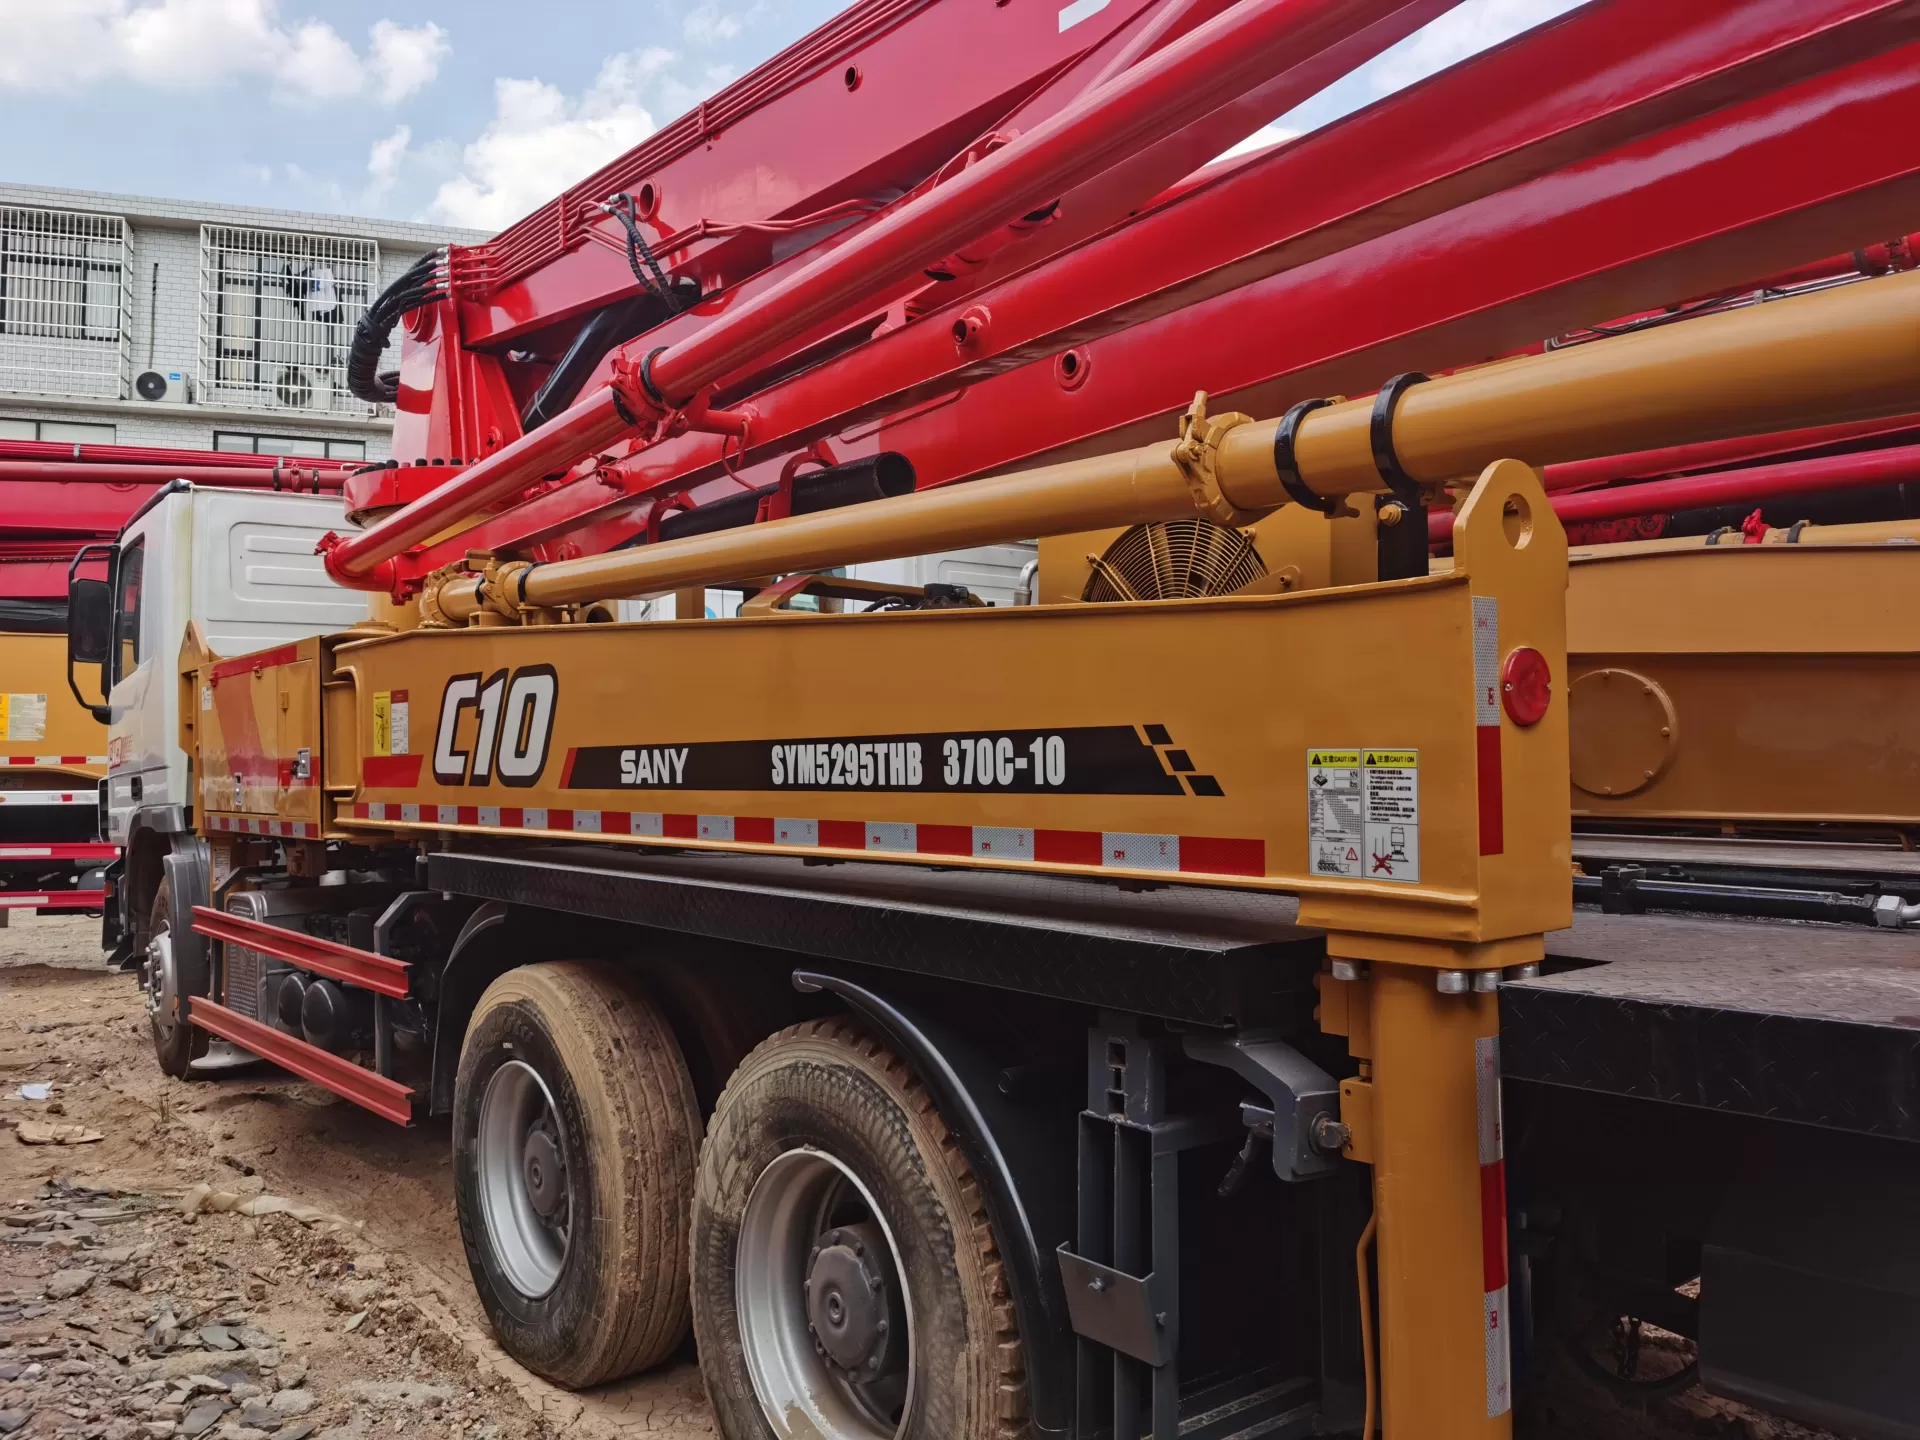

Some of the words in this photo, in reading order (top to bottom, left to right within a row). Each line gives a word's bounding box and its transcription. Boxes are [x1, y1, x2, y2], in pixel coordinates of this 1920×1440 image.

[433, 663, 559, 787] C10
[620, 747, 689, 784] SANY
[771, 742, 923, 786] SYM5295THB
[943, 735, 1066, 786] 370C-10
